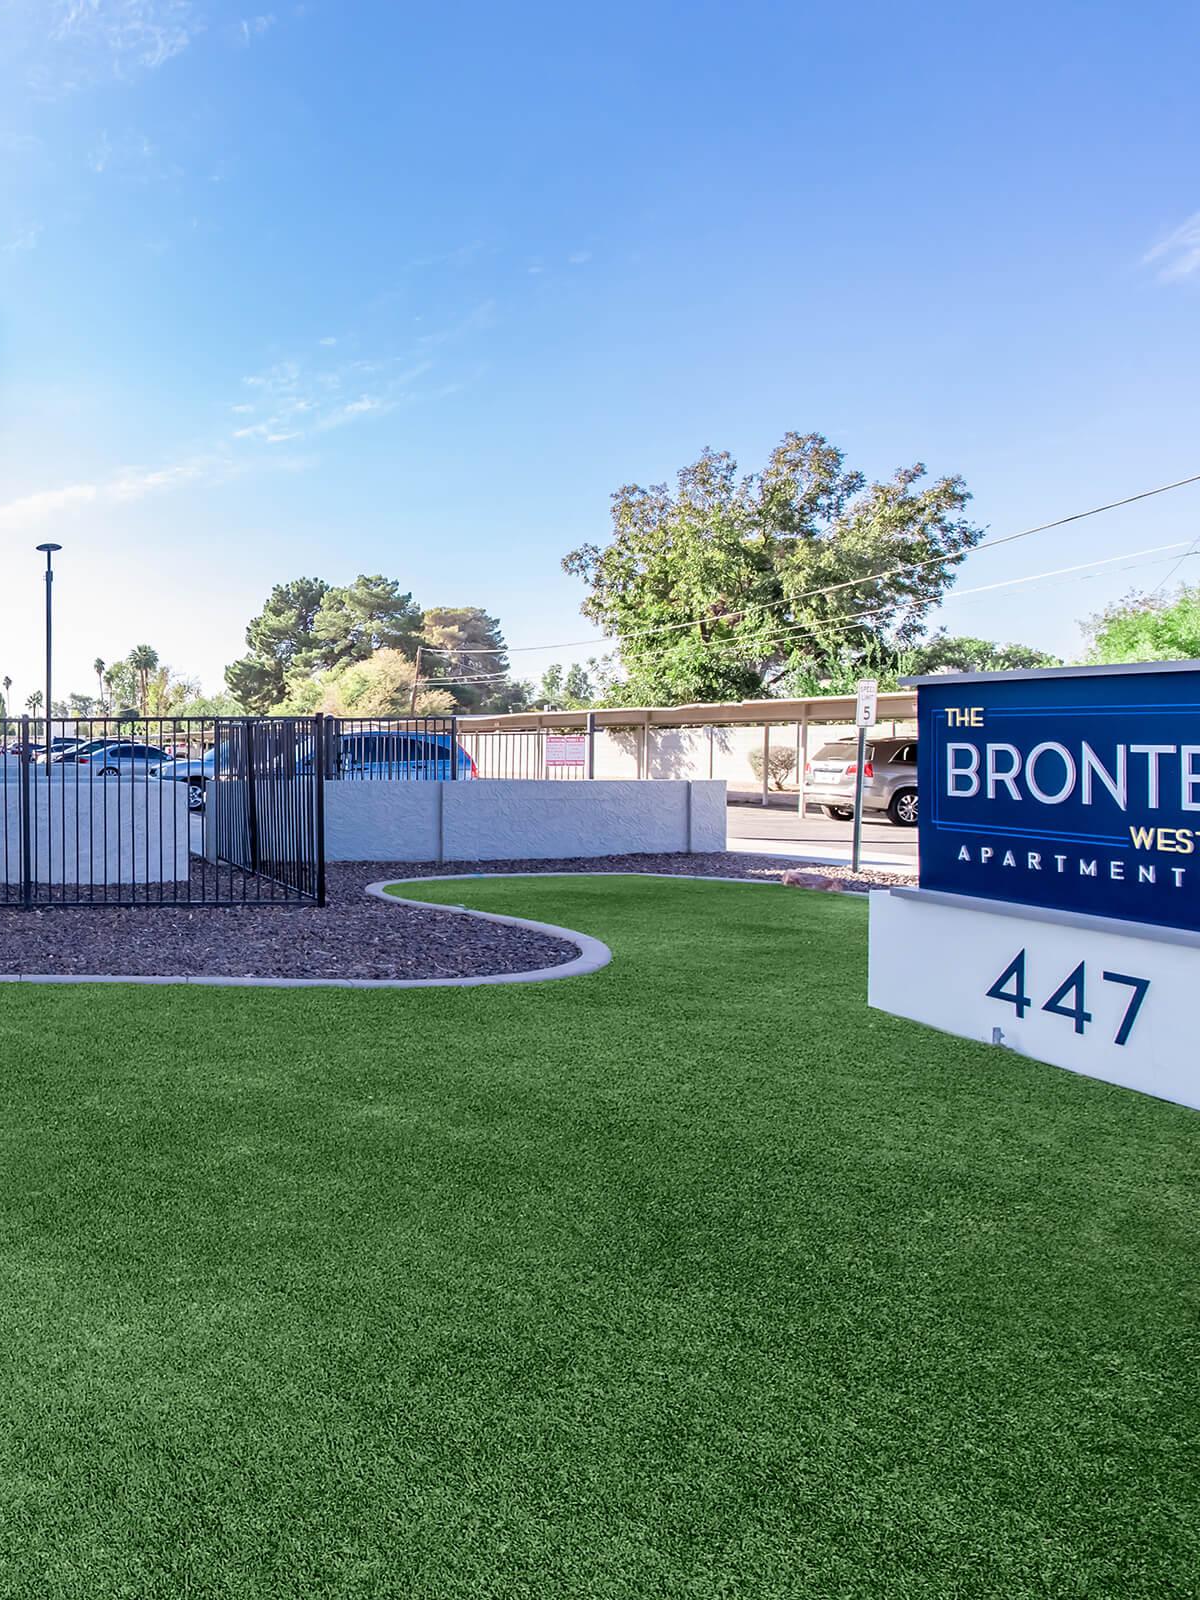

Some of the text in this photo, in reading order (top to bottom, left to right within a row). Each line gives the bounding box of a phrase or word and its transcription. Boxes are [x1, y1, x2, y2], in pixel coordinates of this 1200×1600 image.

[863, 706, 871, 720] 5
[944, 707, 985, 727] THE
[1129, 825, 1200, 854] WES
[985, 947, 1151, 1046] 447
